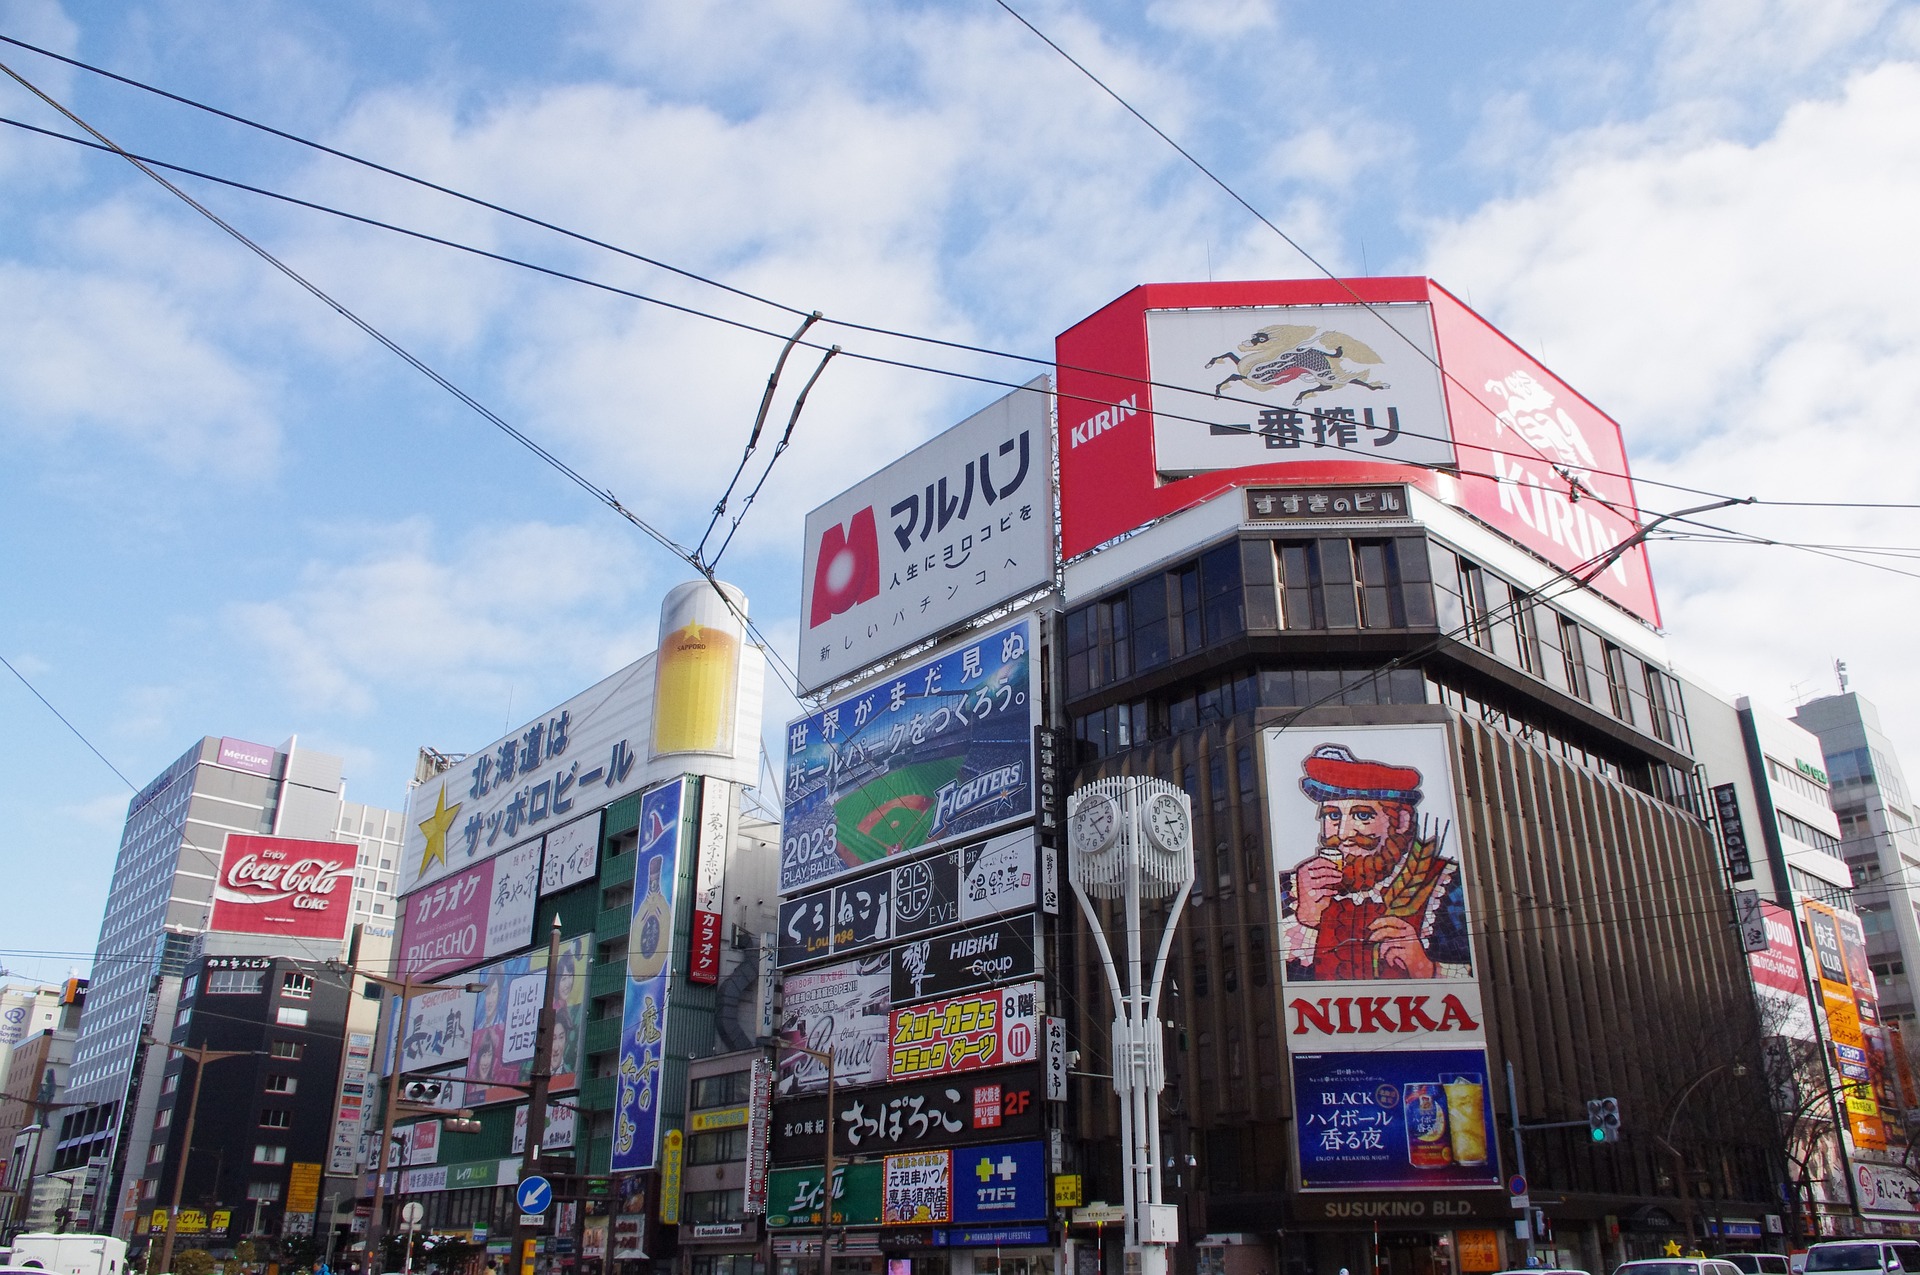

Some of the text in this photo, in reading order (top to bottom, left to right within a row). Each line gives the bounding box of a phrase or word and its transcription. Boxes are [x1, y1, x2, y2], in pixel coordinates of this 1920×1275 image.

[1072, 394, 1137, 449] KIRIN
[1209, 405, 1401, 450] 一番搾り
[891, 430, 1030, 553] マルハン
[1254, 493, 1401, 515] すすきのビル
[1492, 448, 1628, 587] KIRIN
[889, 504, 1032, 590] 人生にヨロコビを
[820, 558, 1017, 662] 新しいパチンコへ
[677, 641, 706, 652] SAPPORO
[790, 631, 1025, 755] 世界がまだ見ぬ
[788, 676, 1025, 792] ボールパークをつくろう。
[223, 749, 269, 766] Mercure
[469, 710, 571, 800] 北海道は
[1041, 732, 1056, 829] すすきのビル
[463, 738, 636, 858] サッポロビール
[928, 760, 1025, 839] FIGHTERS
[262, 849, 287, 861] Enjoy
[783, 823, 838, 869] 2023
[966, 850, 978, 864] 2F
[228, 854, 344, 895] Coca-Cola
[783, 859, 836, 884] PLAY BALL
[293, 893, 330, 911] Coke
[415, 874, 482, 926] カラオケ
[928, 901, 958, 926] EVE
[787, 891, 871, 945] くろねこ
[405, 940, 435, 974] BIG
[435, 923, 477, 957] ECHO
[699, 913, 715, 969] カラオケ
[806, 928, 854, 952] Lounge
[949, 933, 999, 960] HIBIKI
[1814, 921, 1837, 951] 快活
[972, 955, 1013, 977] Group
[1820, 950, 1842, 973] CLUB
[512, 983, 539, 1008] パッと!
[1004, 993, 1034, 1019] 8階
[511, 1005, 537, 1030] ピッと!
[894, 997, 997, 1046] ネットカフェ
[1288, 993, 1480, 1036] NIKKA
[402, 1008, 465, 1060] 長次郎
[892, 1033, 996, 1074] コミック ダーツ
[1004, 1090, 1030, 1116] 2F
[1321, 1091, 1375, 1105] BLACK
[784, 1117, 836, 1137] 北の味紀
[840, 1088, 963, 1146] さっぽろっこ
[1305, 1109, 1394, 1127] ハイボール
[1319, 1126, 1385, 1151] 香る夜
[888, 1168, 941, 1188] 元祖串かつ
[888, 1186, 947, 1205] 恵美須商店
[1324, 1200, 1477, 1218] SUSUKINO BLD.
[701, 1227, 724, 1235] Susukino
[971, 1231, 1031, 1241] HOKKAIDO HAPPY LIFESTYLE
